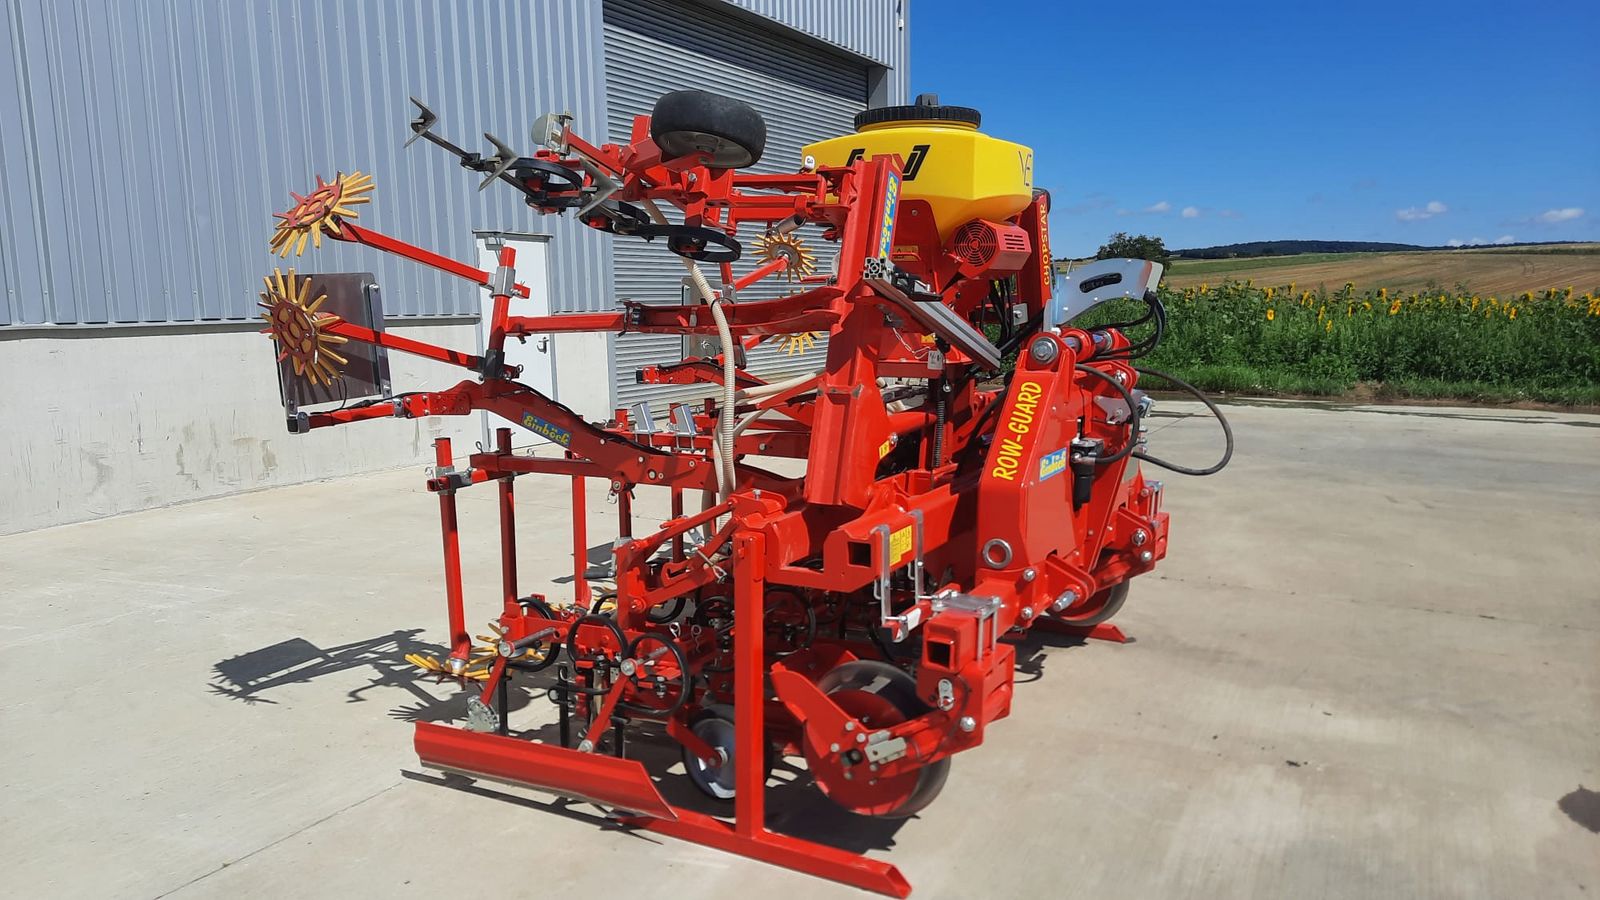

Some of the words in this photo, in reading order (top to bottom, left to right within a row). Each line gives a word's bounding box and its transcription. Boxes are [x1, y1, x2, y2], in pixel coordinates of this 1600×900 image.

[1040, 203, 1050, 286] CHOPSTAR
[523, 415, 569, 444] Einböck
[993, 382, 1042, 480] ROW-GUARD
